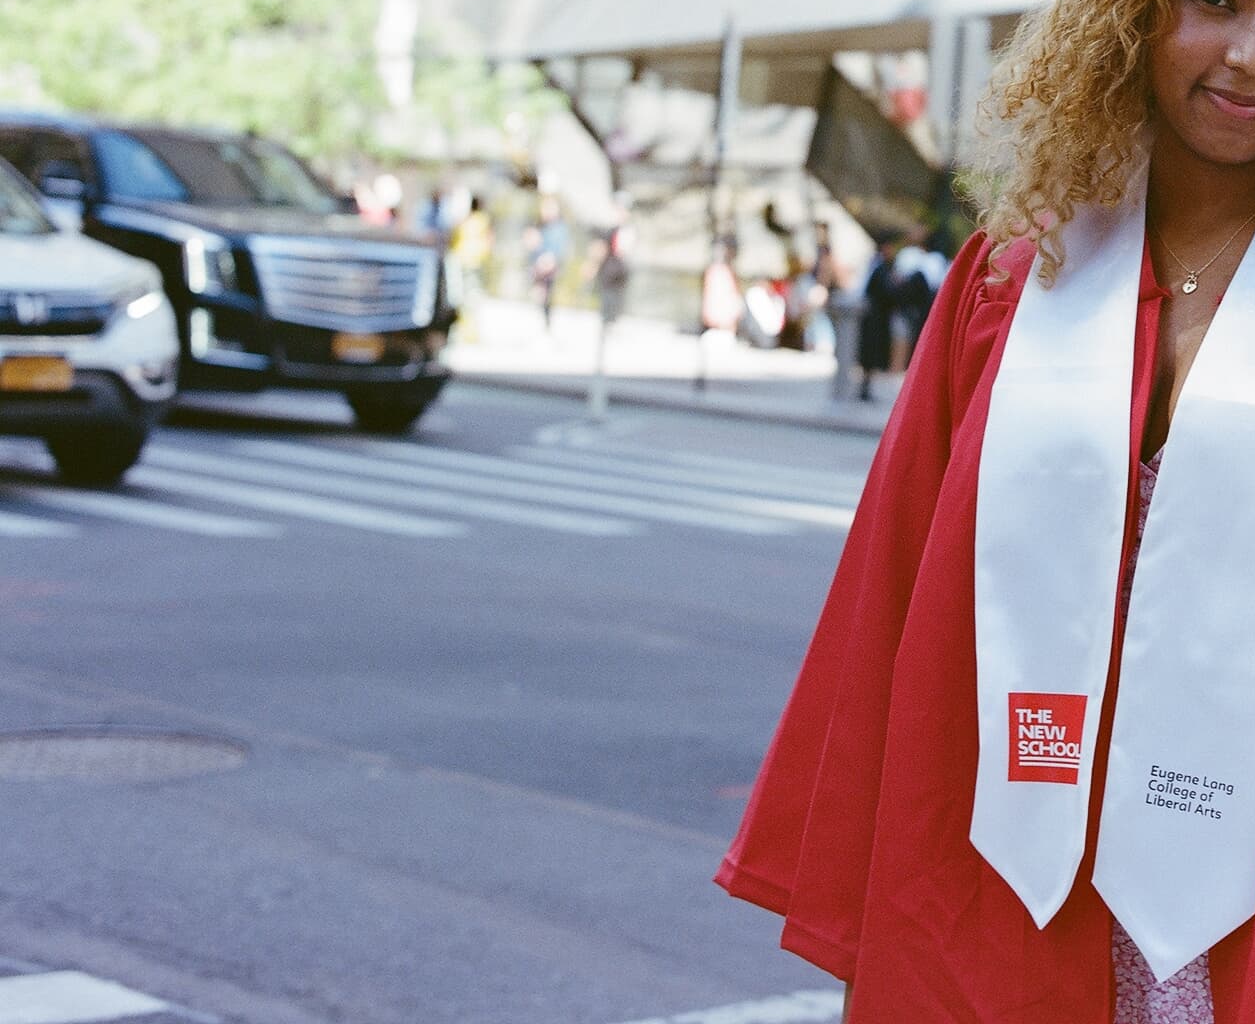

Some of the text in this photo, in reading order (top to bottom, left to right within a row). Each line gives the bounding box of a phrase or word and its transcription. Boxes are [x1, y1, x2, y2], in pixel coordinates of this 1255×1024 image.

[1015, 708, 1053, 724] THE
[1018, 724, 1067, 741] NEW
[1018, 740, 1081, 758] SCHOOL
[1147, 779, 1215, 802] College of
[1150, 765, 1234, 796] Eugene Lang
[1145, 793, 1222, 819] Liberal Arts
